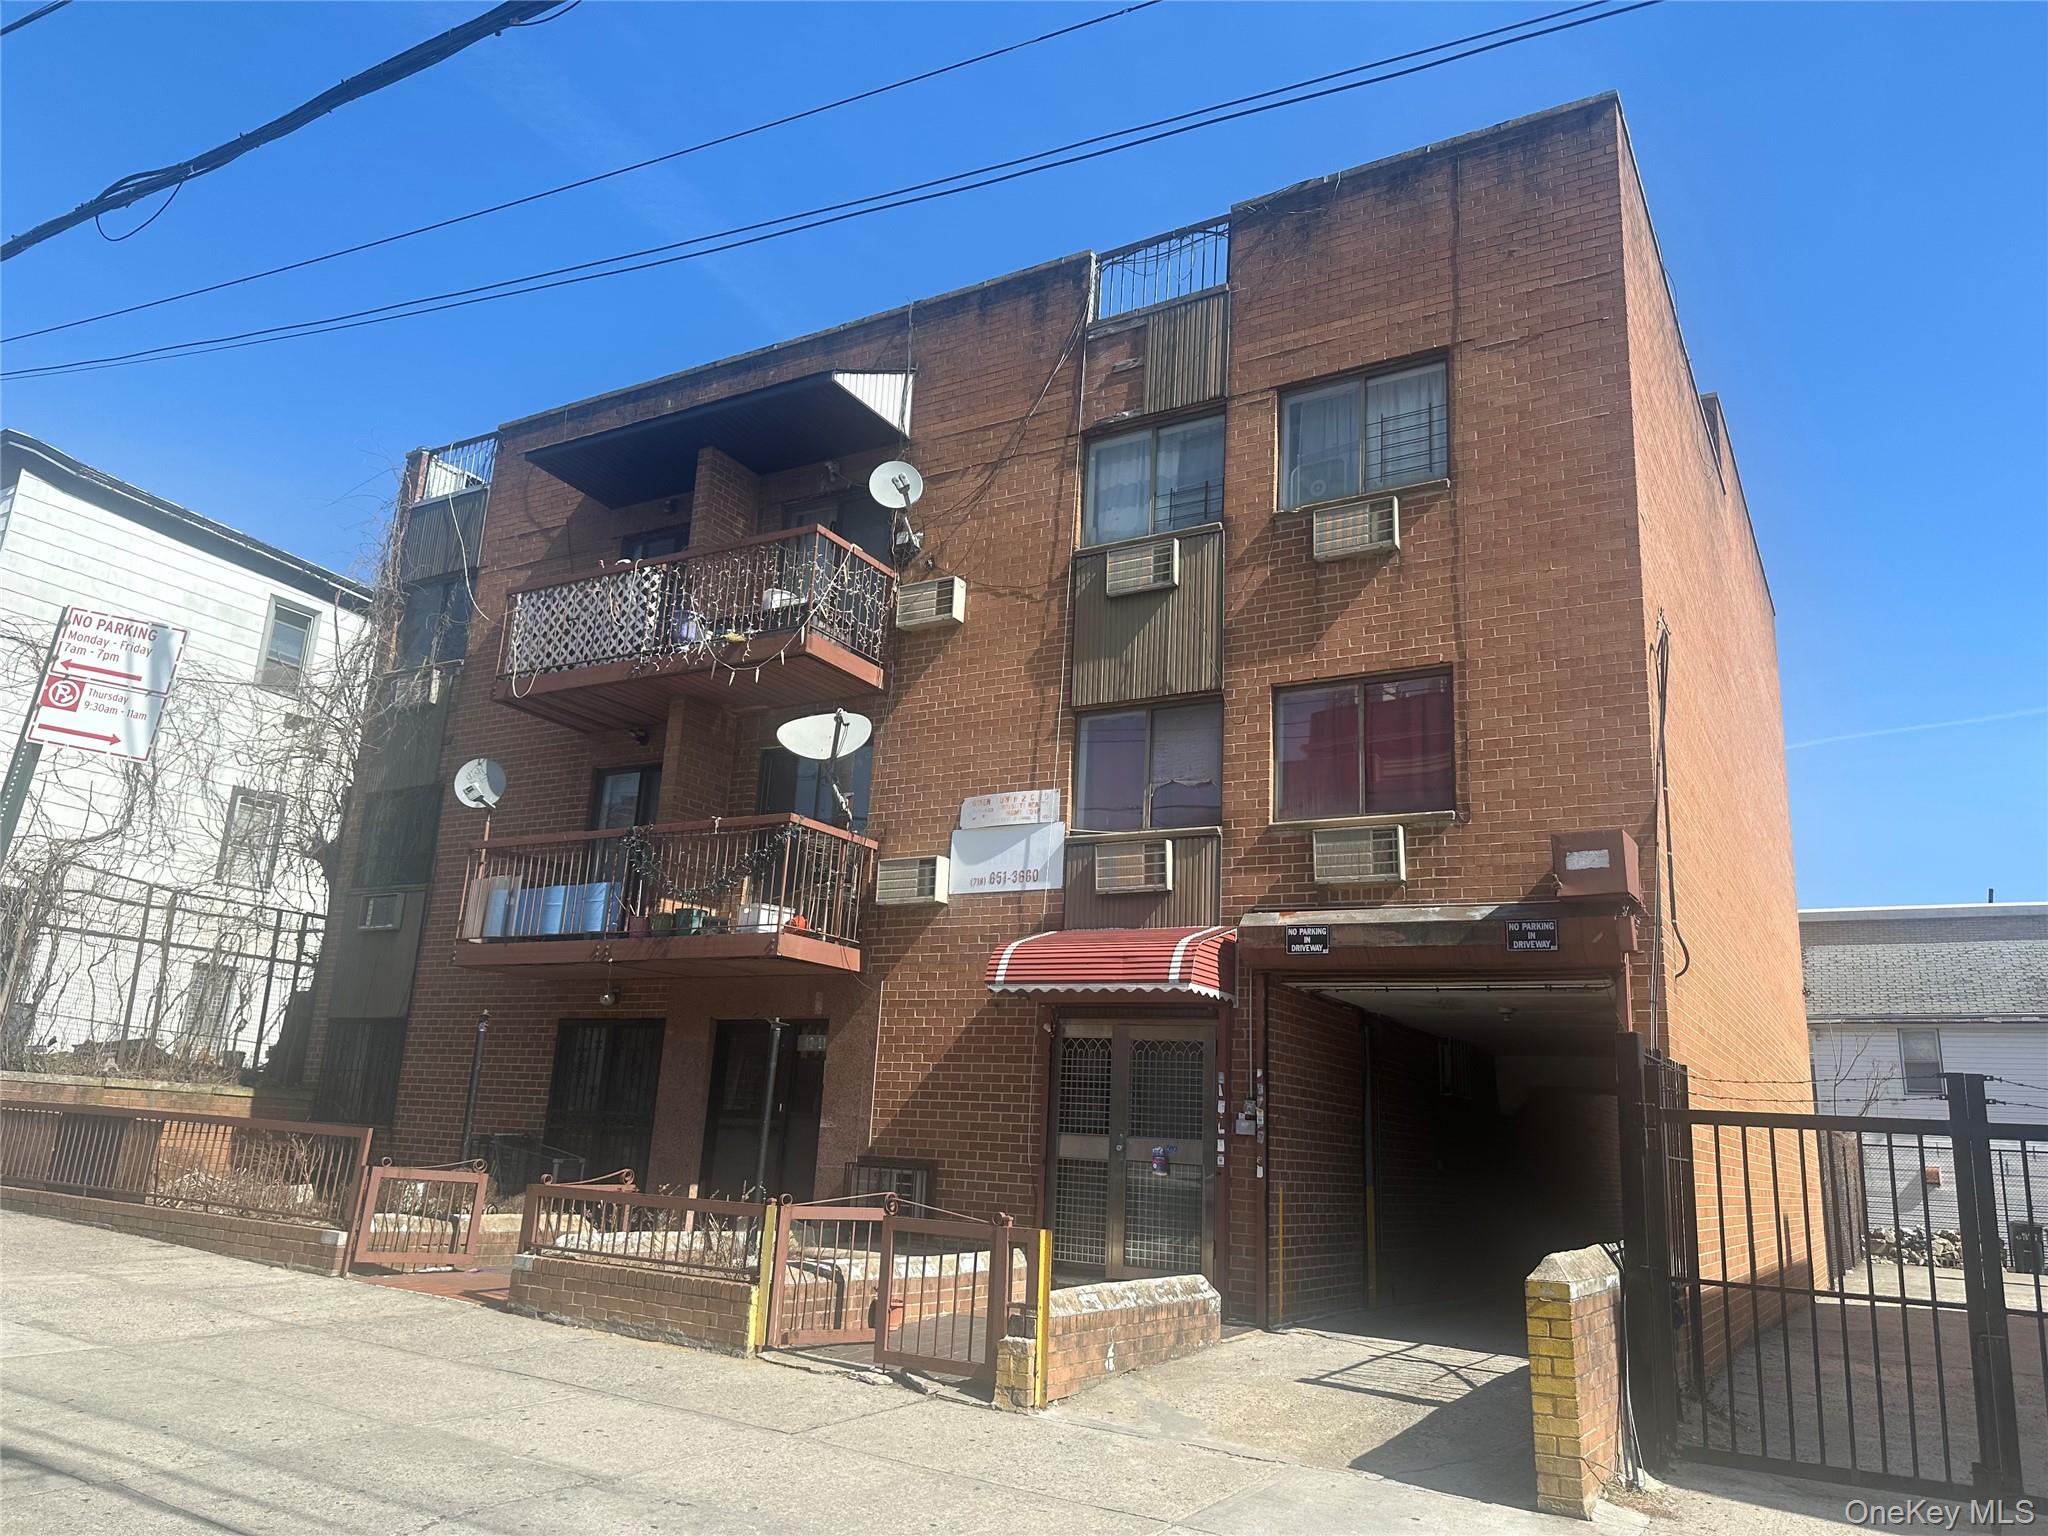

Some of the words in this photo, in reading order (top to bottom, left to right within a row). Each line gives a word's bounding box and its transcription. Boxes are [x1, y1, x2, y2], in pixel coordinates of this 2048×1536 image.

[72, 613, 93, 628] NO
[96, 618, 158, 642] PARKING
[67, 630, 110, 648] Monday
[120, 640, 153, 658] Friday
[64, 642, 87, 656] 7am
[97, 648, 120, 663] 7pm
[88, 688, 129, 705] Thursday
[83, 701, 118, 715] 9:30am
[126, 709, 148, 720] 11am
[1508, 922, 1519, 931] NO
[1521, 922, 1555, 931] PARKING
[1288, 928, 1298, 936] NO
[1299, 927, 1327, 936] PARKING
[1527, 931, 1536, 940] IN
[1303, 936, 1311, 944] IN
[1513, 940, 1551, 949] DRIVEWAY
[1291, 944, 1323, 952] DRIVEWAY
